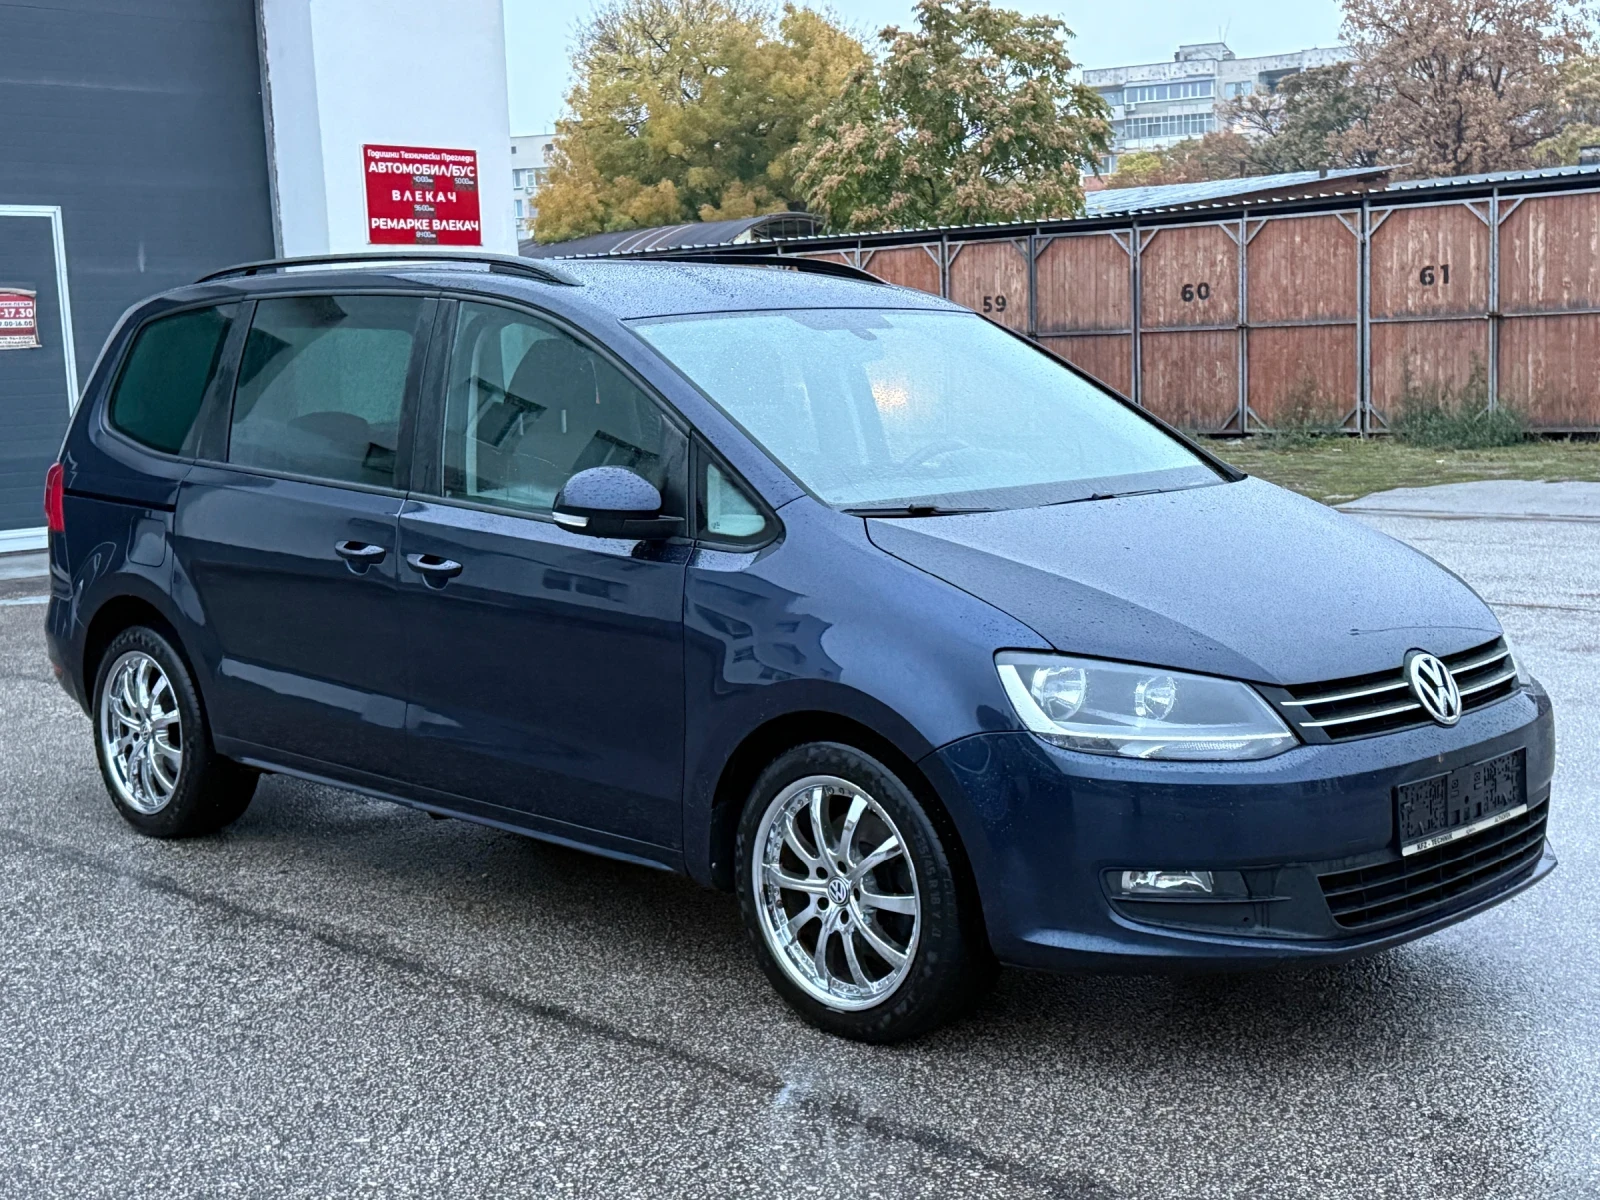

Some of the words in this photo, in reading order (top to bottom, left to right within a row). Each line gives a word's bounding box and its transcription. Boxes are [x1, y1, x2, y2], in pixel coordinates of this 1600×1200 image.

[368, 162, 475, 177] АВТОМОБИЛ/БУС
[392, 190, 457, 202] ВЛЕКАЧ
[371, 218, 430, 229] РЕМАРКЕ
[432, 219, 479, 231] ВЛЕКАЧ
[1419, 264, 1449, 286] 61
[1181, 282, 1210, 302] 60
[983, 295, 1006, 312] 59
